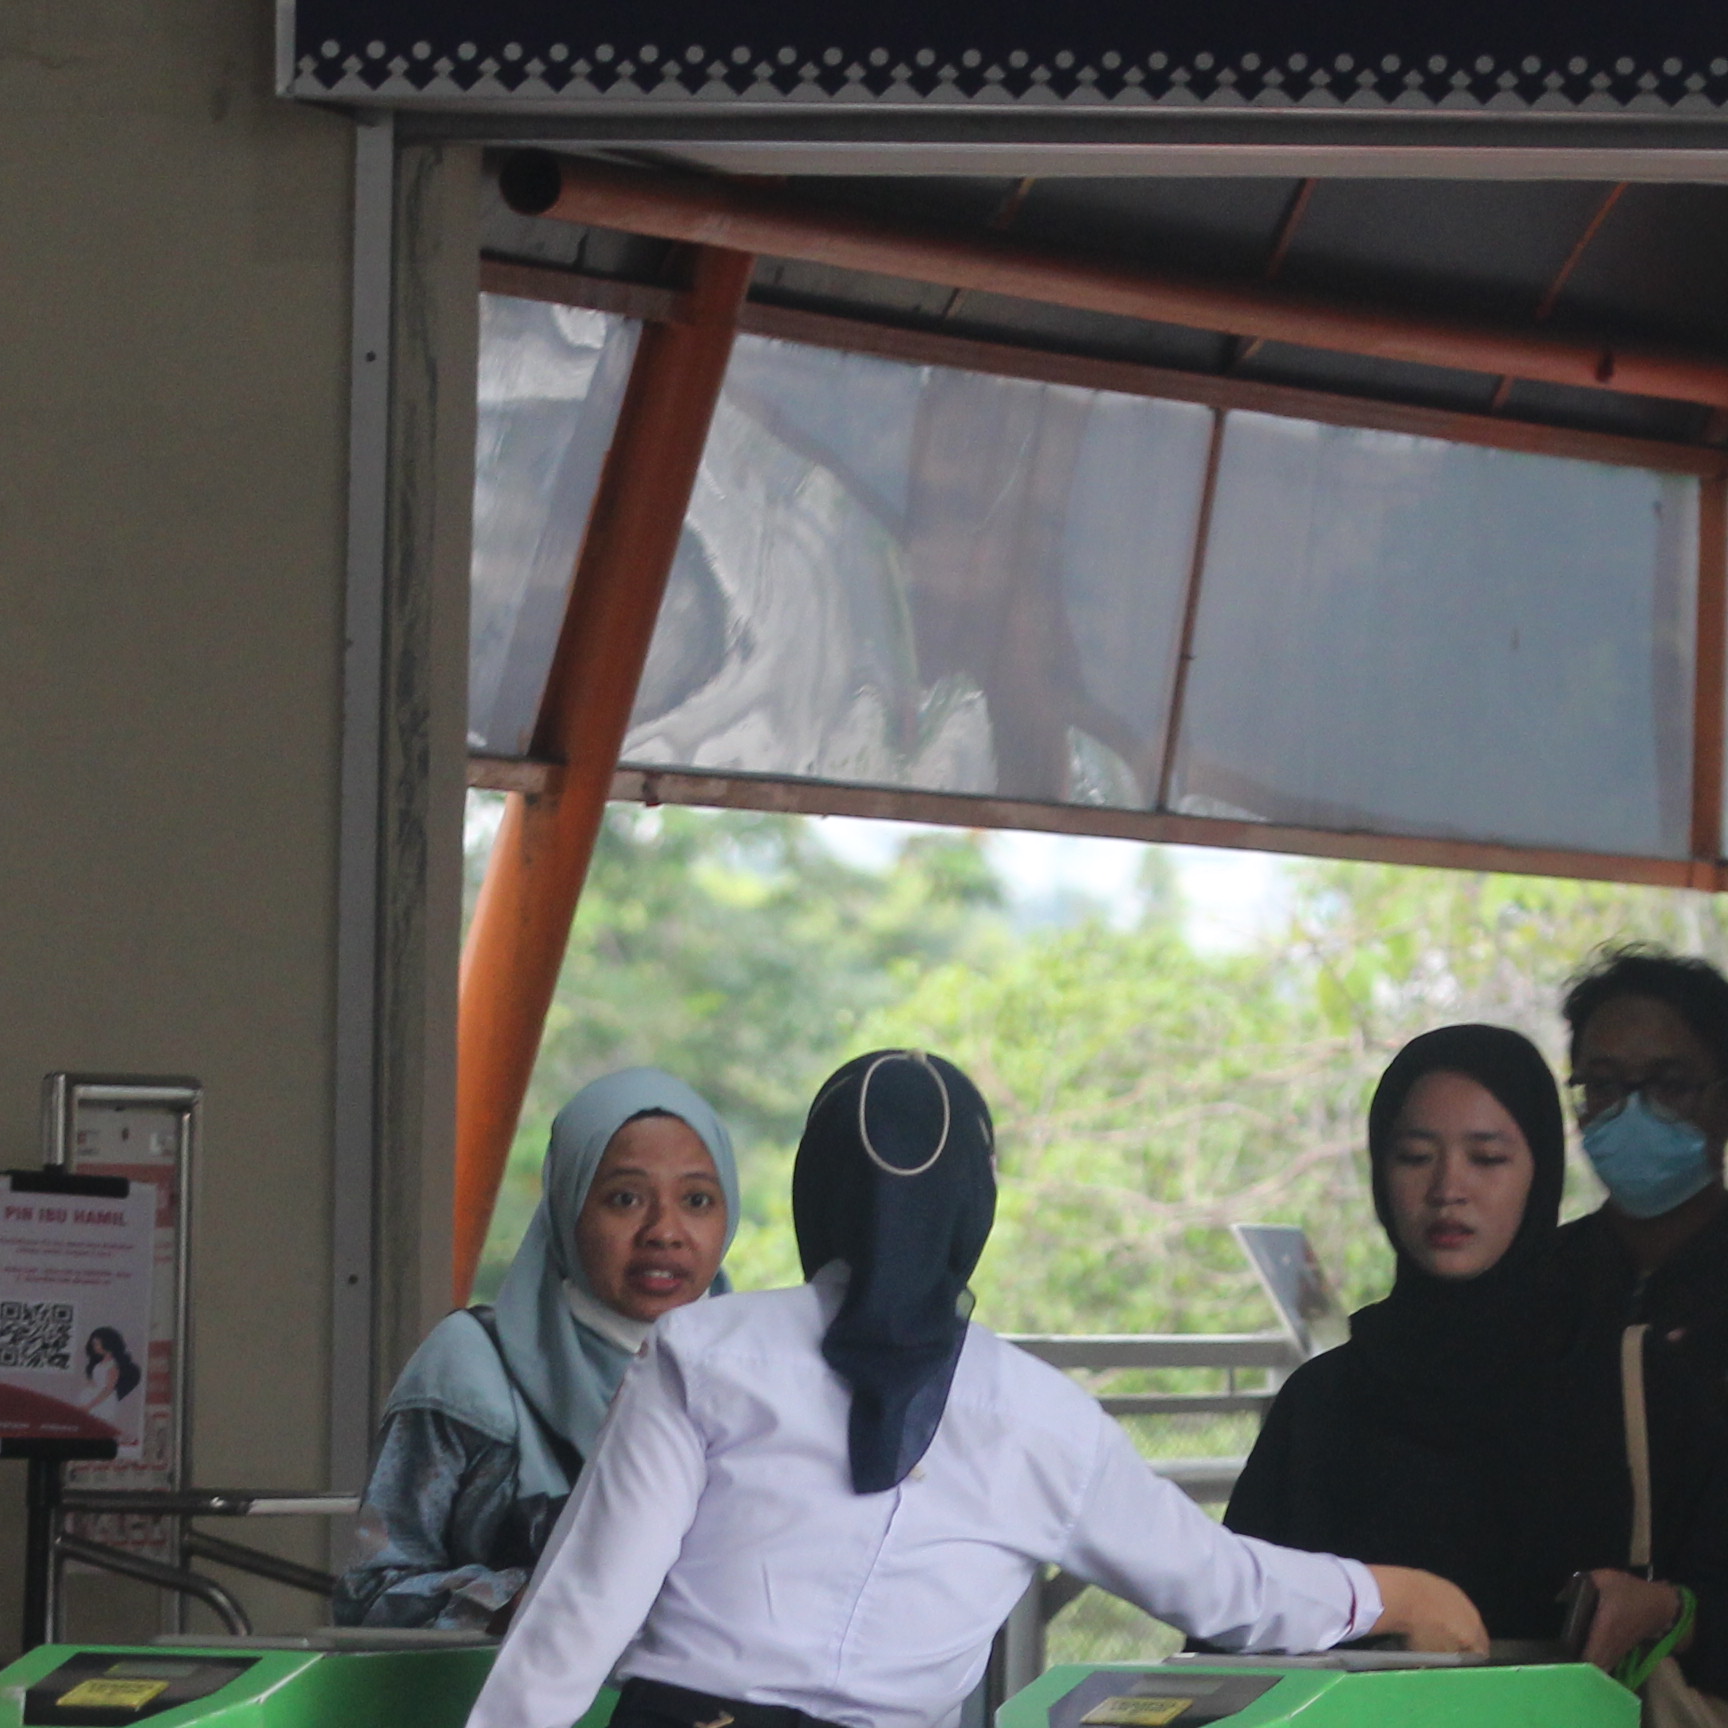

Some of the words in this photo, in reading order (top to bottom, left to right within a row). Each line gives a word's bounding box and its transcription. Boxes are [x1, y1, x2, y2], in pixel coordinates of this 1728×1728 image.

[4, 1205, 34, 1220] PIN
[38, 1207, 68, 1224] IBU
[73, 1209, 128, 1227] HAMIL
